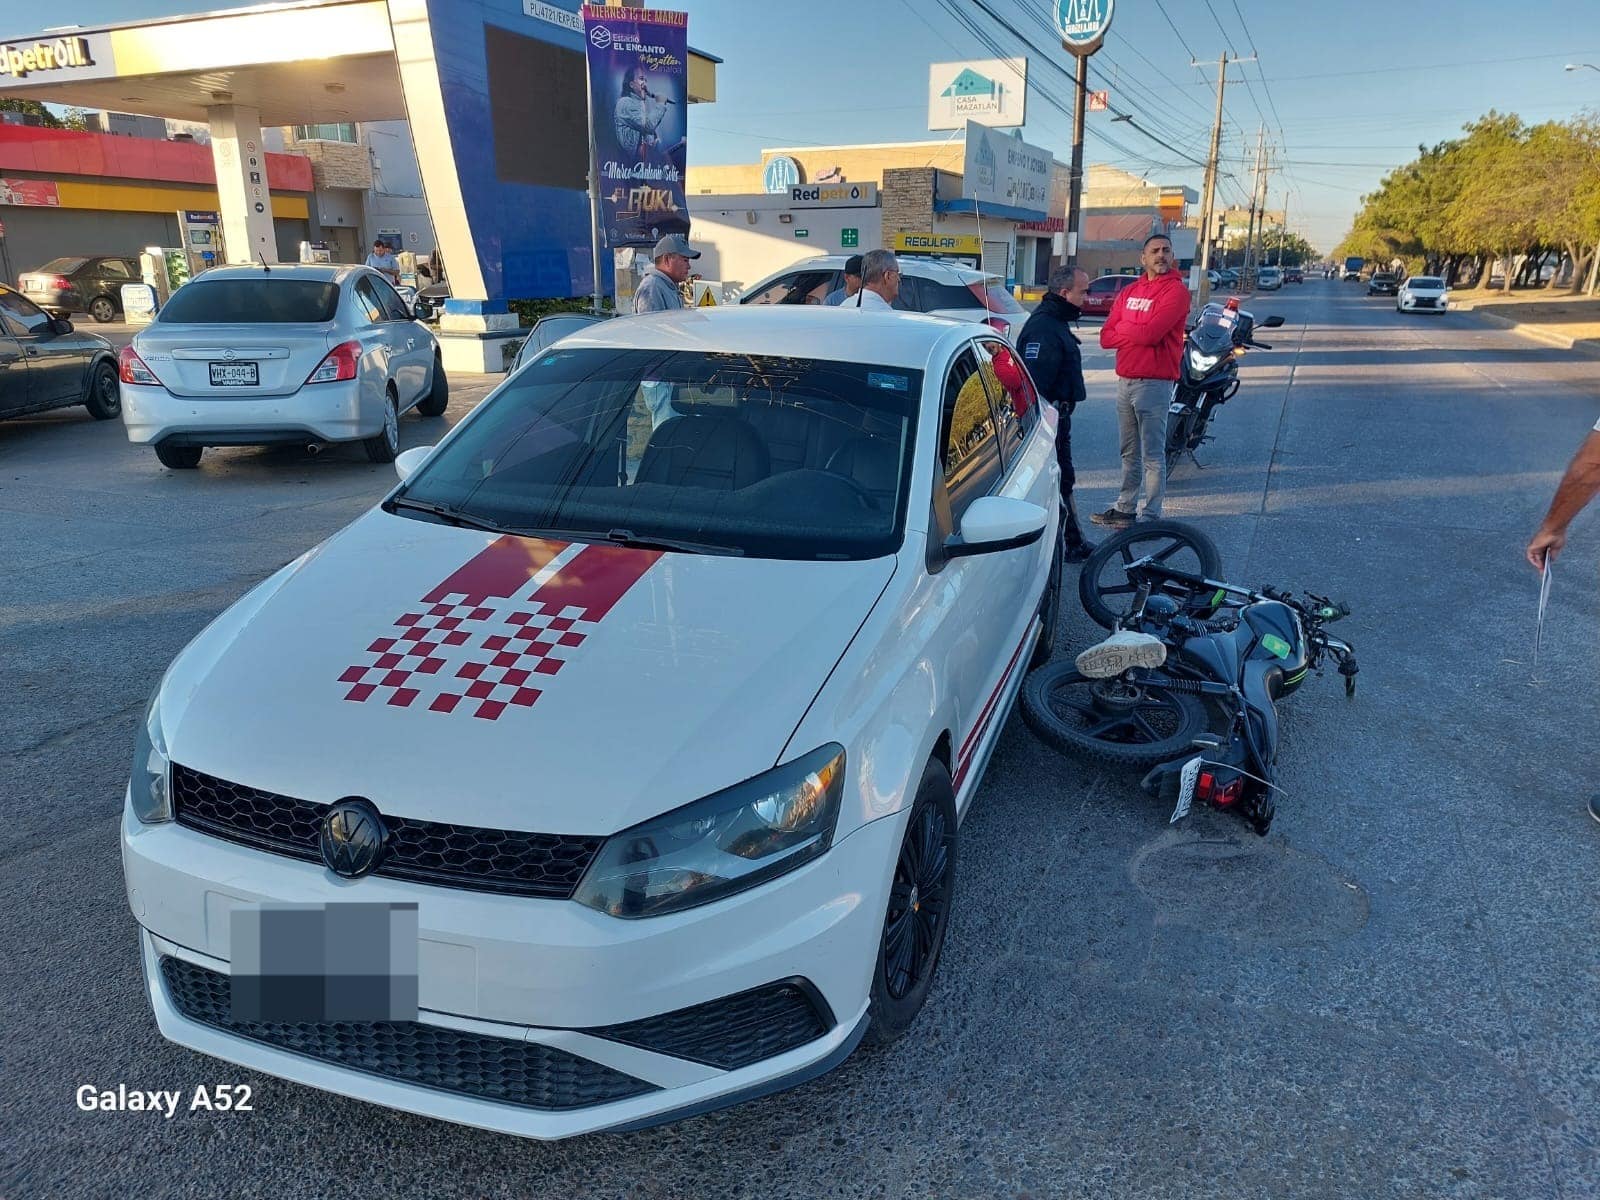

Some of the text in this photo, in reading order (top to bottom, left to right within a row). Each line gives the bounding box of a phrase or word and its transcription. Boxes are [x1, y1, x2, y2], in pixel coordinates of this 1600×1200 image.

[590, 5, 626, 19] VIERNES
[642, 8, 652, 21] DE
[655, 9, 684, 25] MARZO
[612, 33, 640, 43] Estadio
[613, 43, 666, 54] EL ENCANTO
[956, 96, 977, 104] CASA
[904, 236, 954, 248] REGULAR
